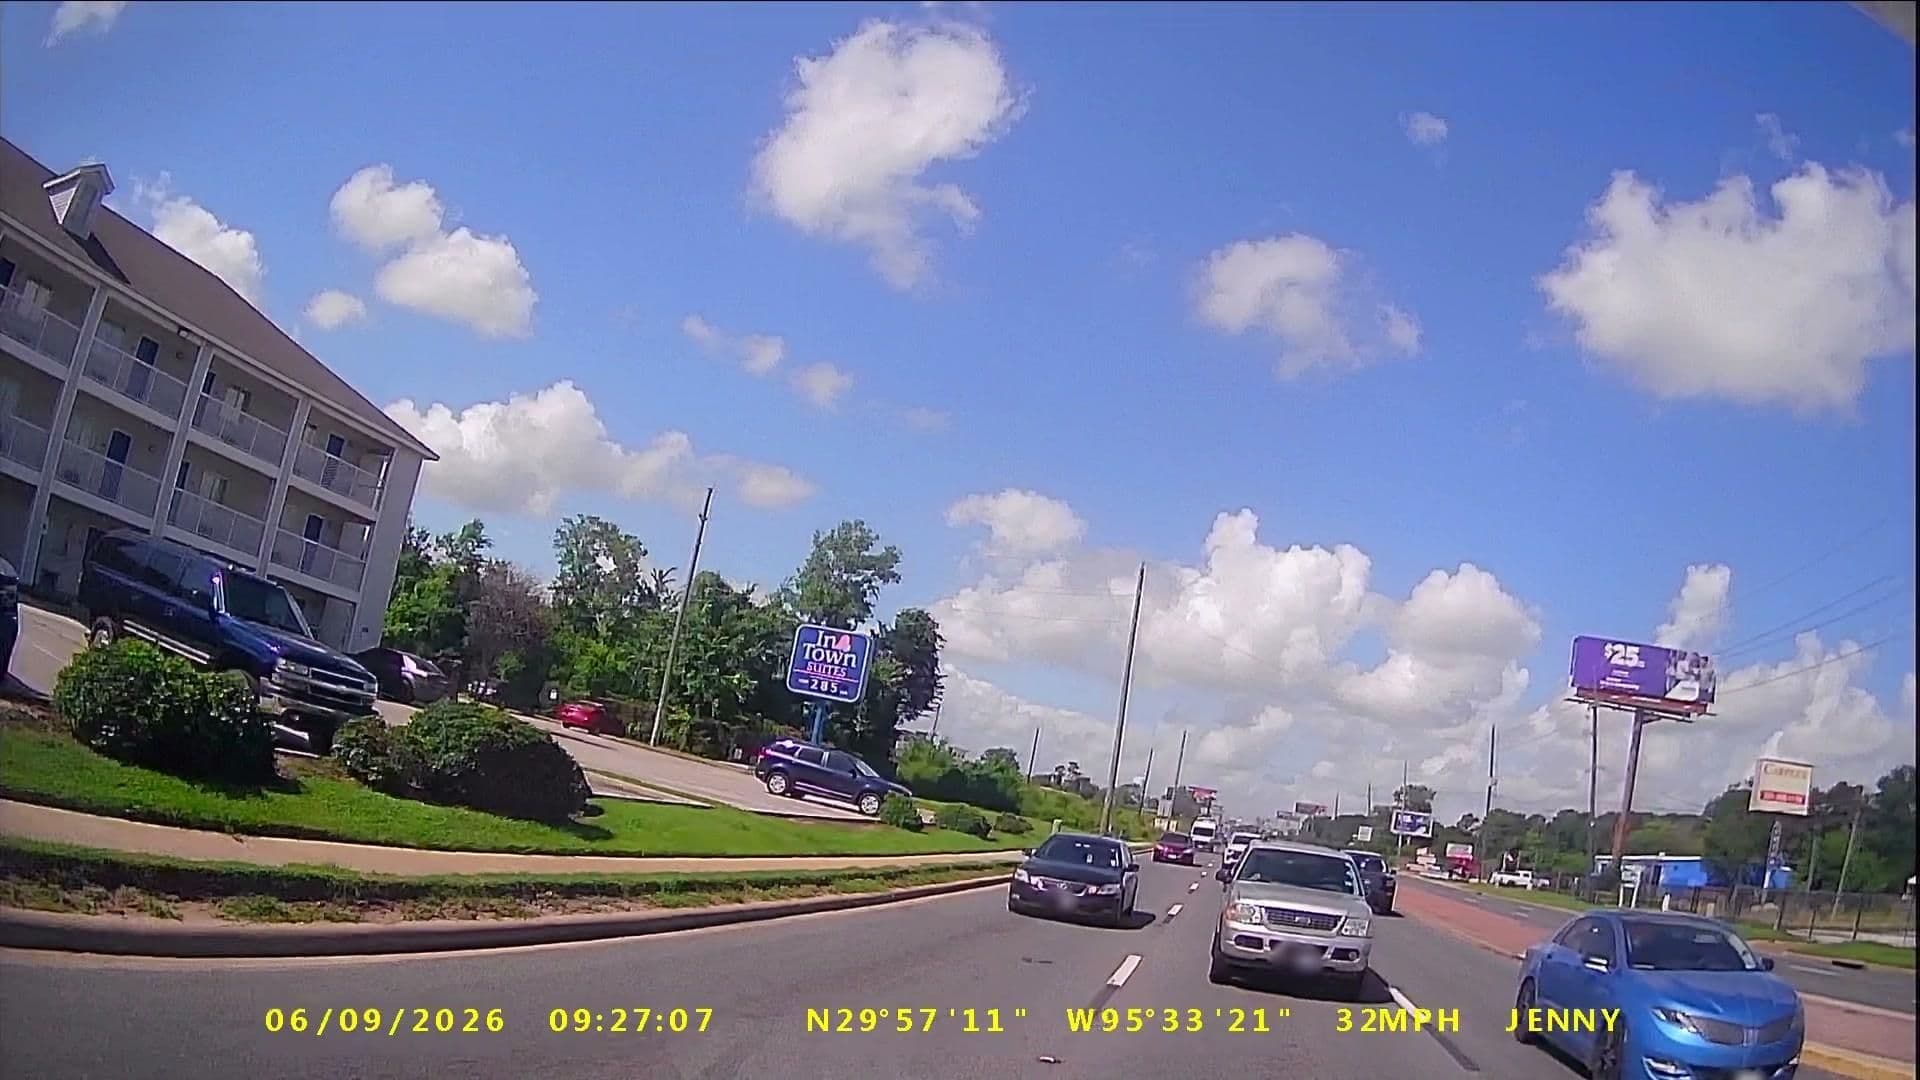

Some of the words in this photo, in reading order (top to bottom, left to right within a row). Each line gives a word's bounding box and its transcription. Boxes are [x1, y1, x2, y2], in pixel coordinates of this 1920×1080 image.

[816, 630, 837, 649] In
[806, 661, 849, 678] SUITES
[810, 679, 839, 694] 285
